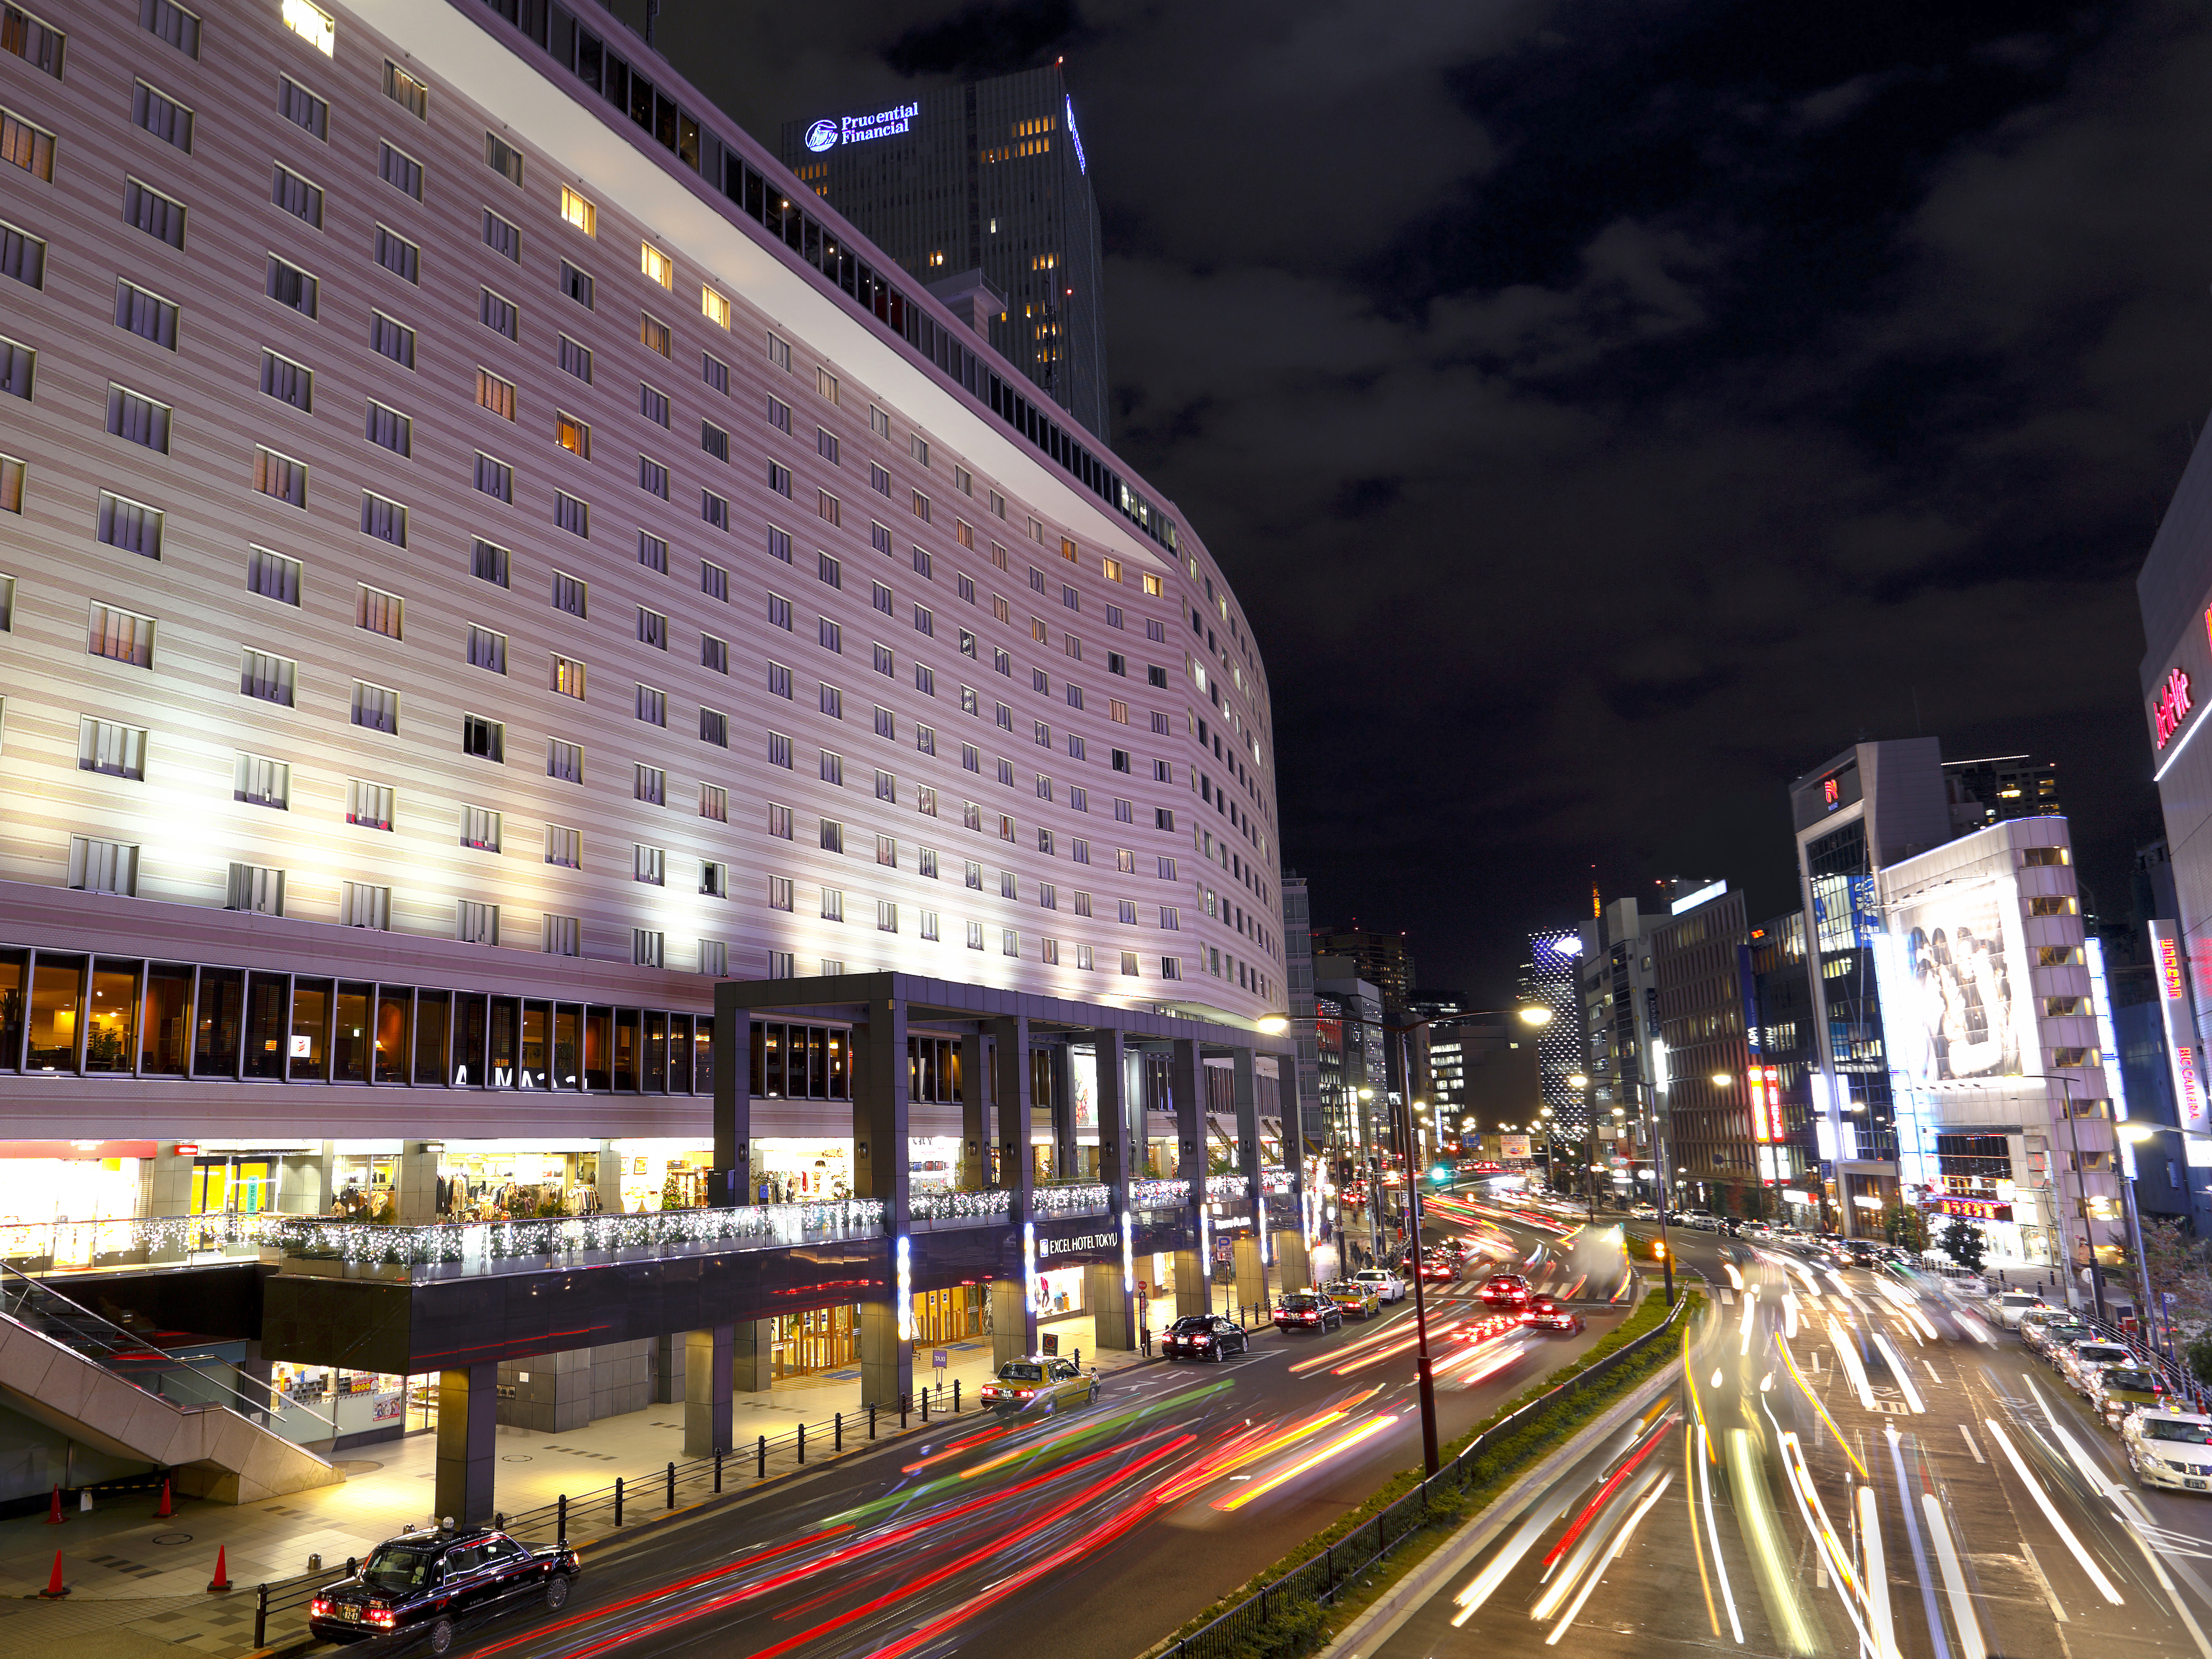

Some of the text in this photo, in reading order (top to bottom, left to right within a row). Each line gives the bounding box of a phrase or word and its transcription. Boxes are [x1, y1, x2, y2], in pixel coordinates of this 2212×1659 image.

[841, 118, 909, 145] Financial
[2178, 1047, 2202, 1120] BIC CAMERA
[1050, 1232, 1118, 1254] EXCEL HOTEL TOKYU
[1218, 1237, 1230, 1249] P
